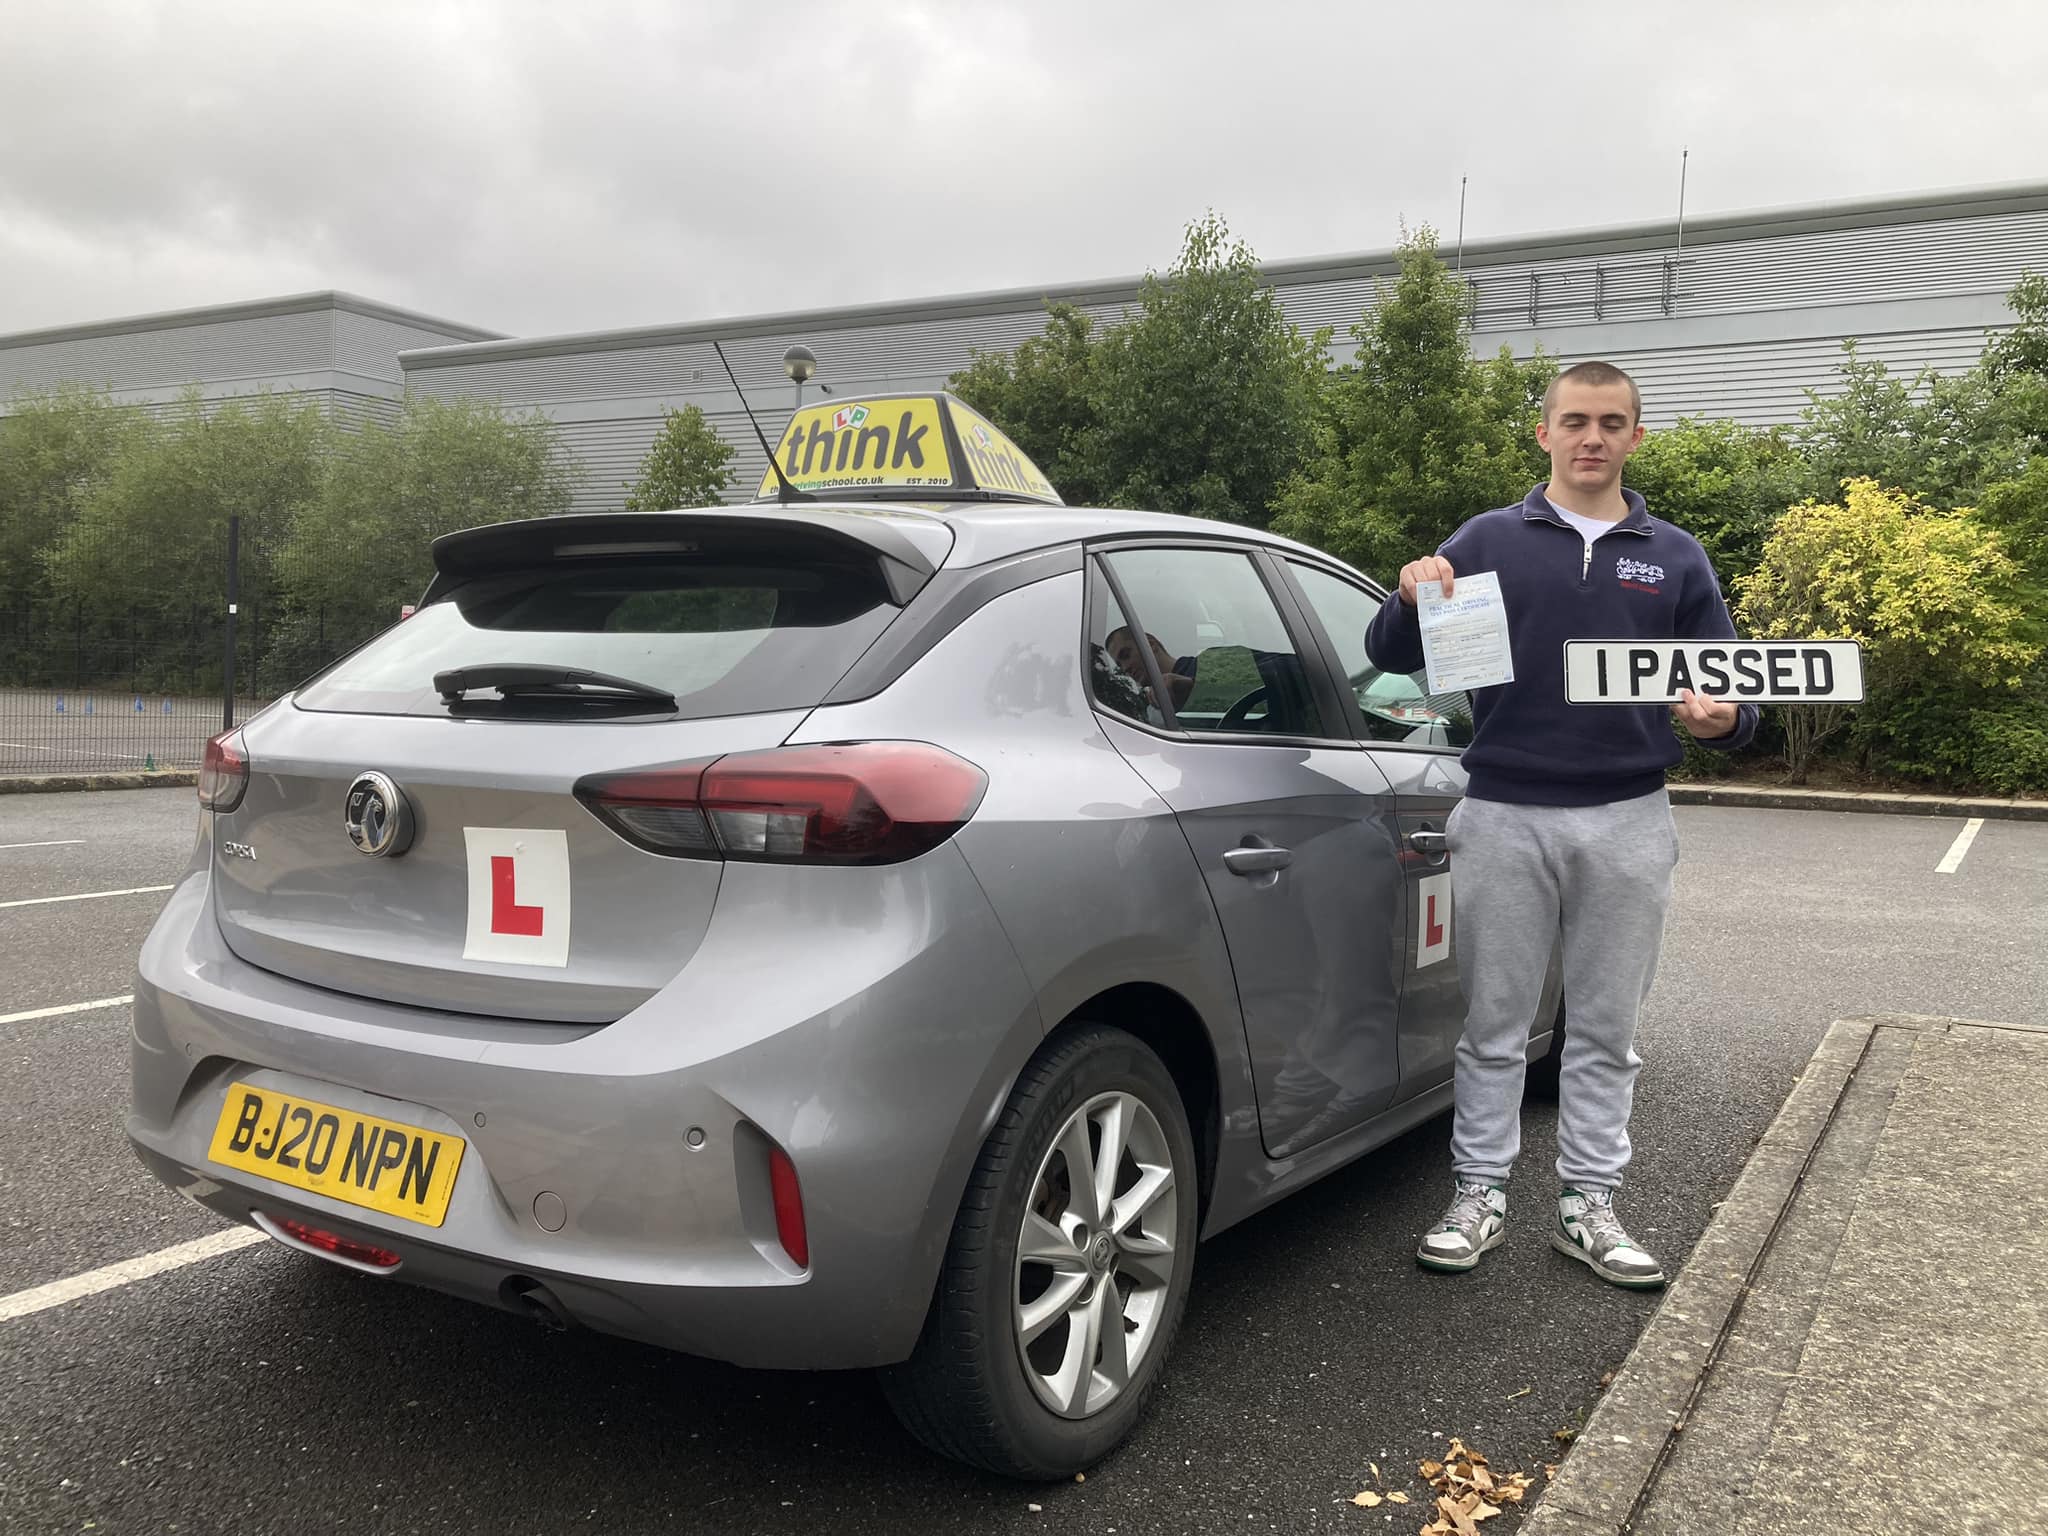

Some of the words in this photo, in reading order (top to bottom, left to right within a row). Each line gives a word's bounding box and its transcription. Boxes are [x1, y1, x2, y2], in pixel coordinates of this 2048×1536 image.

[786, 411, 928, 477] think
[836, 412, 847, 428] L
[850, 409, 866, 424] P
[928, 477, 948, 485] 2010
[1597, 649, 1608, 696] I
[1628, 649, 1834, 696] PASSED
[491, 856, 544, 936] L
[1426, 895, 1443, 948] L
[229, 1093, 340, 1175] BJ20
[339, 1121, 441, 1205] NPN
